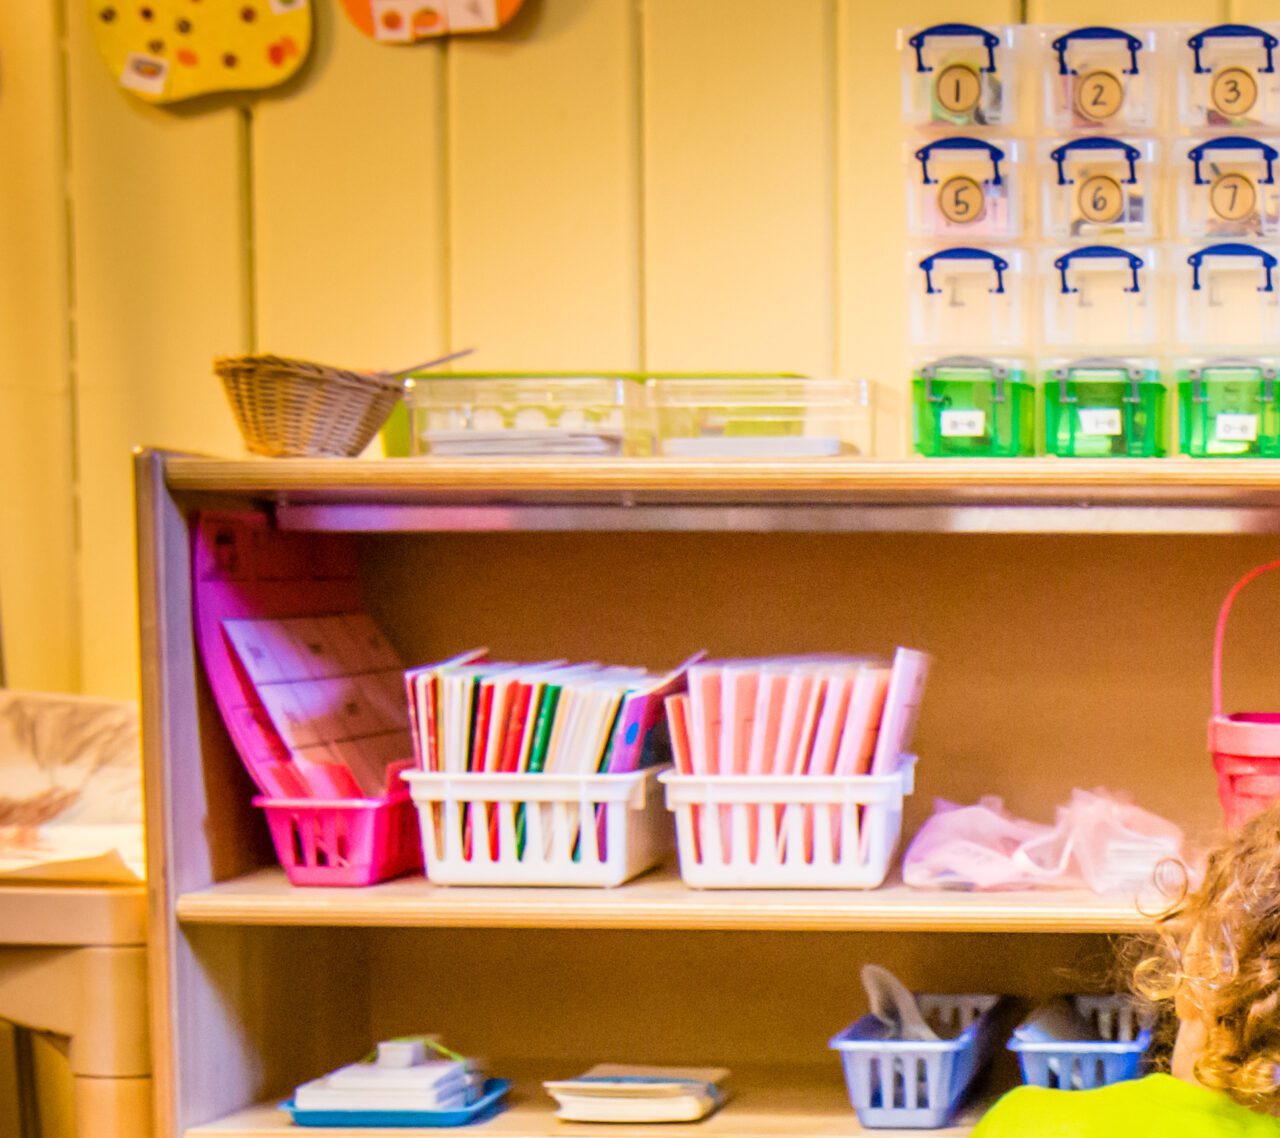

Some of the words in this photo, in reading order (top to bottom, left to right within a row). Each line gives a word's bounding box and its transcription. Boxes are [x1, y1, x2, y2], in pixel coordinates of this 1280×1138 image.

[1091, 84, 1107, 106] 2
[1223, 79, 1241, 104] 3
[953, 186, 970, 216] 5
[1092, 186, 1107, 212] 6
[1223, 184, 1238, 212] 7
